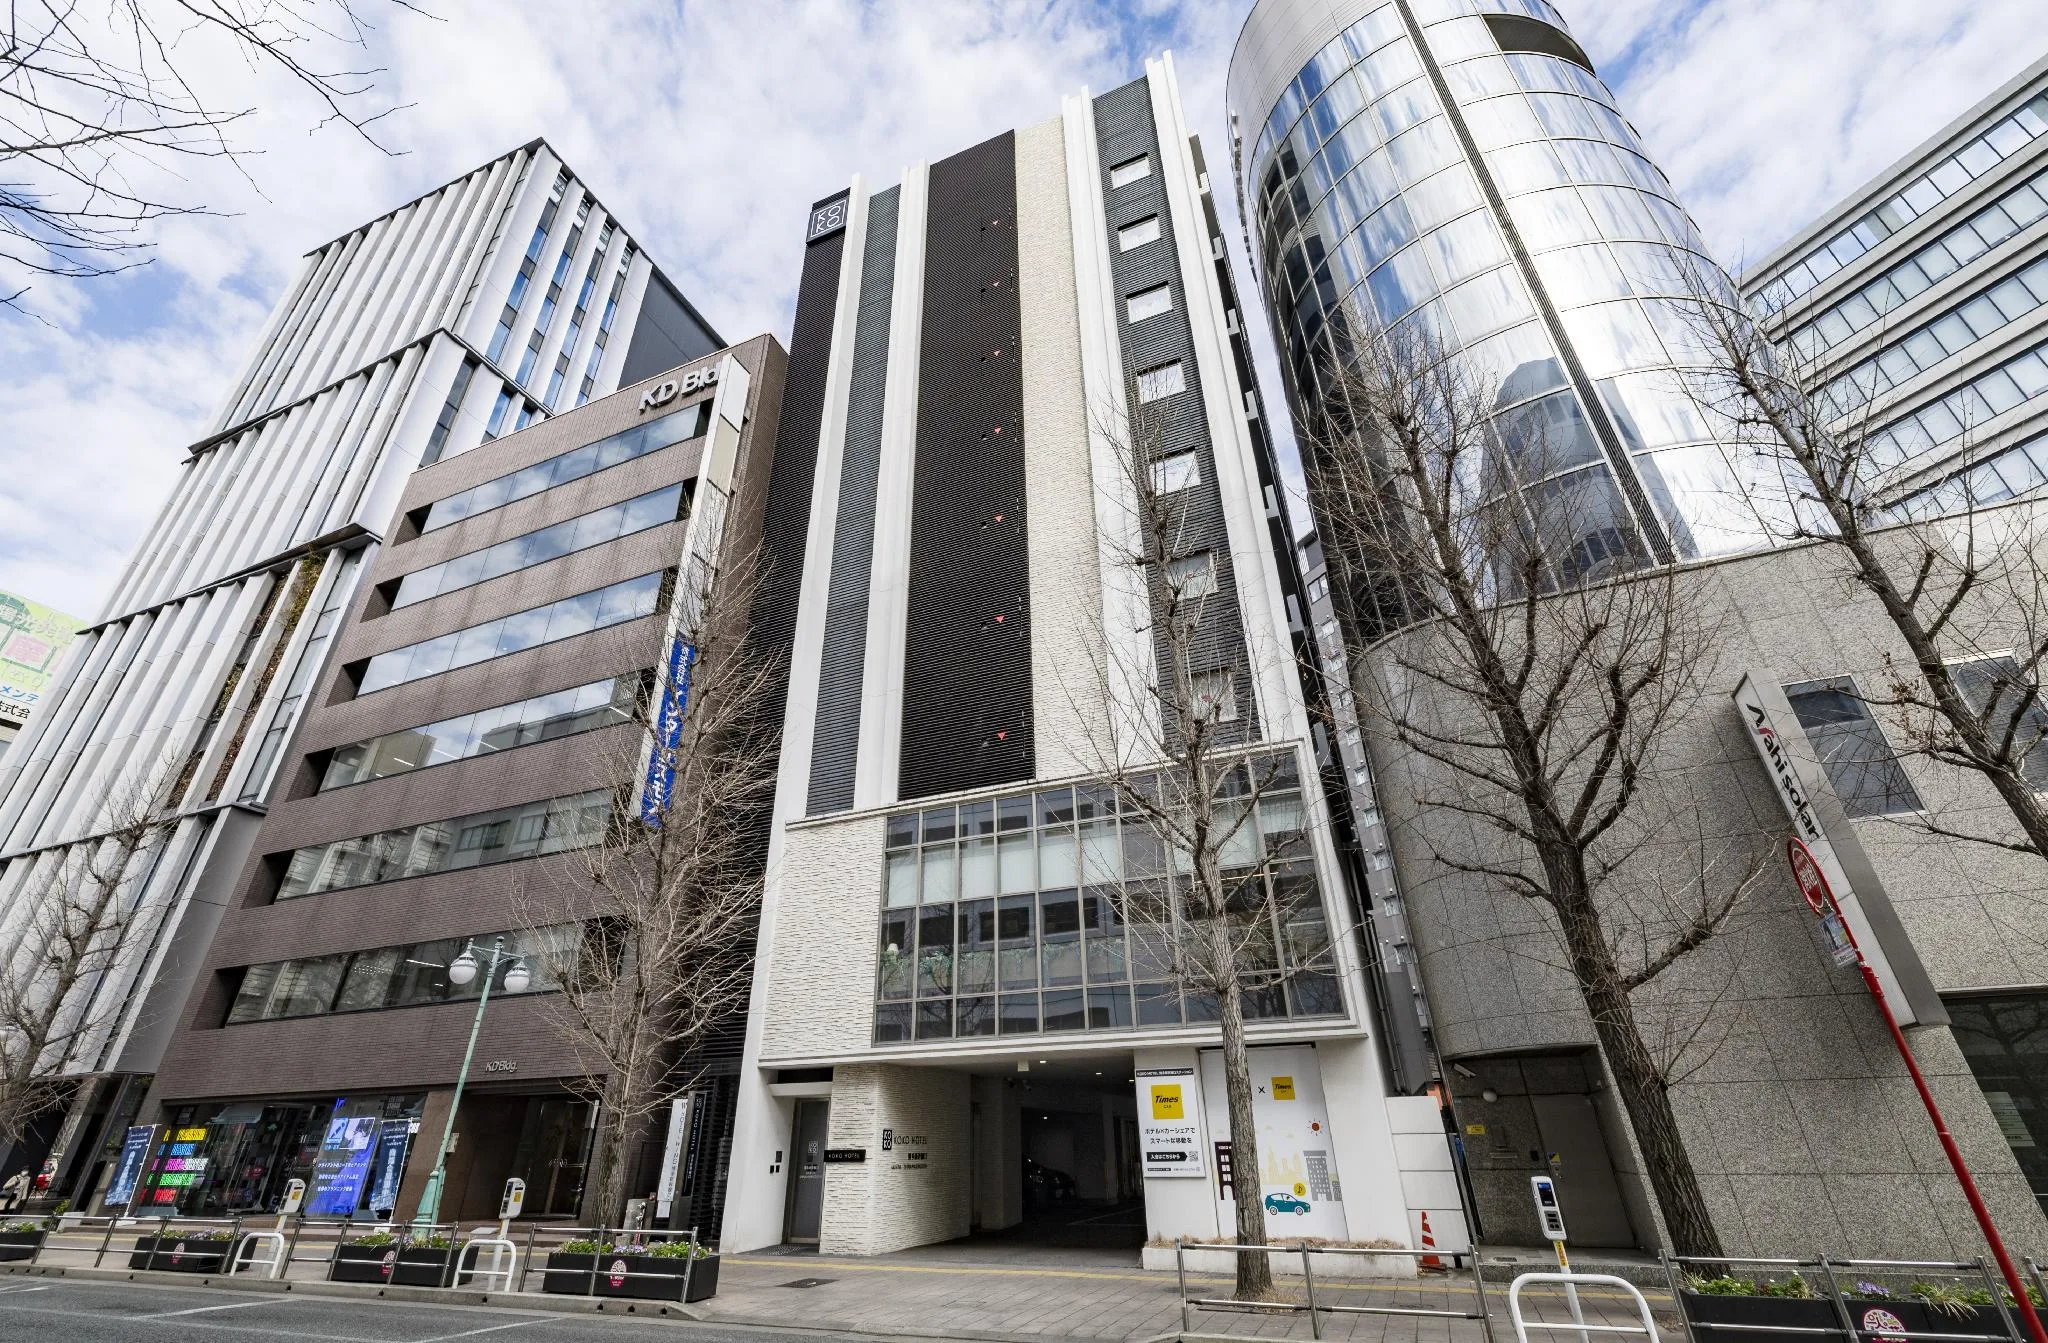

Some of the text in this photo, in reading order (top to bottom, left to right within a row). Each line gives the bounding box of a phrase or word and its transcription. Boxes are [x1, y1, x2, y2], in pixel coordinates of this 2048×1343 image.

[639, 380, 680, 411] KD
[0, 700, 31, 719] 式会
[1746, 703, 1786, 773] Asahi
[1781, 776, 1820, 840] solar
[485, 1061, 499, 1072] KD
[1155, 1095, 1179, 1103] Times
[894, 1135, 928, 1145] KOKO HOTEL
